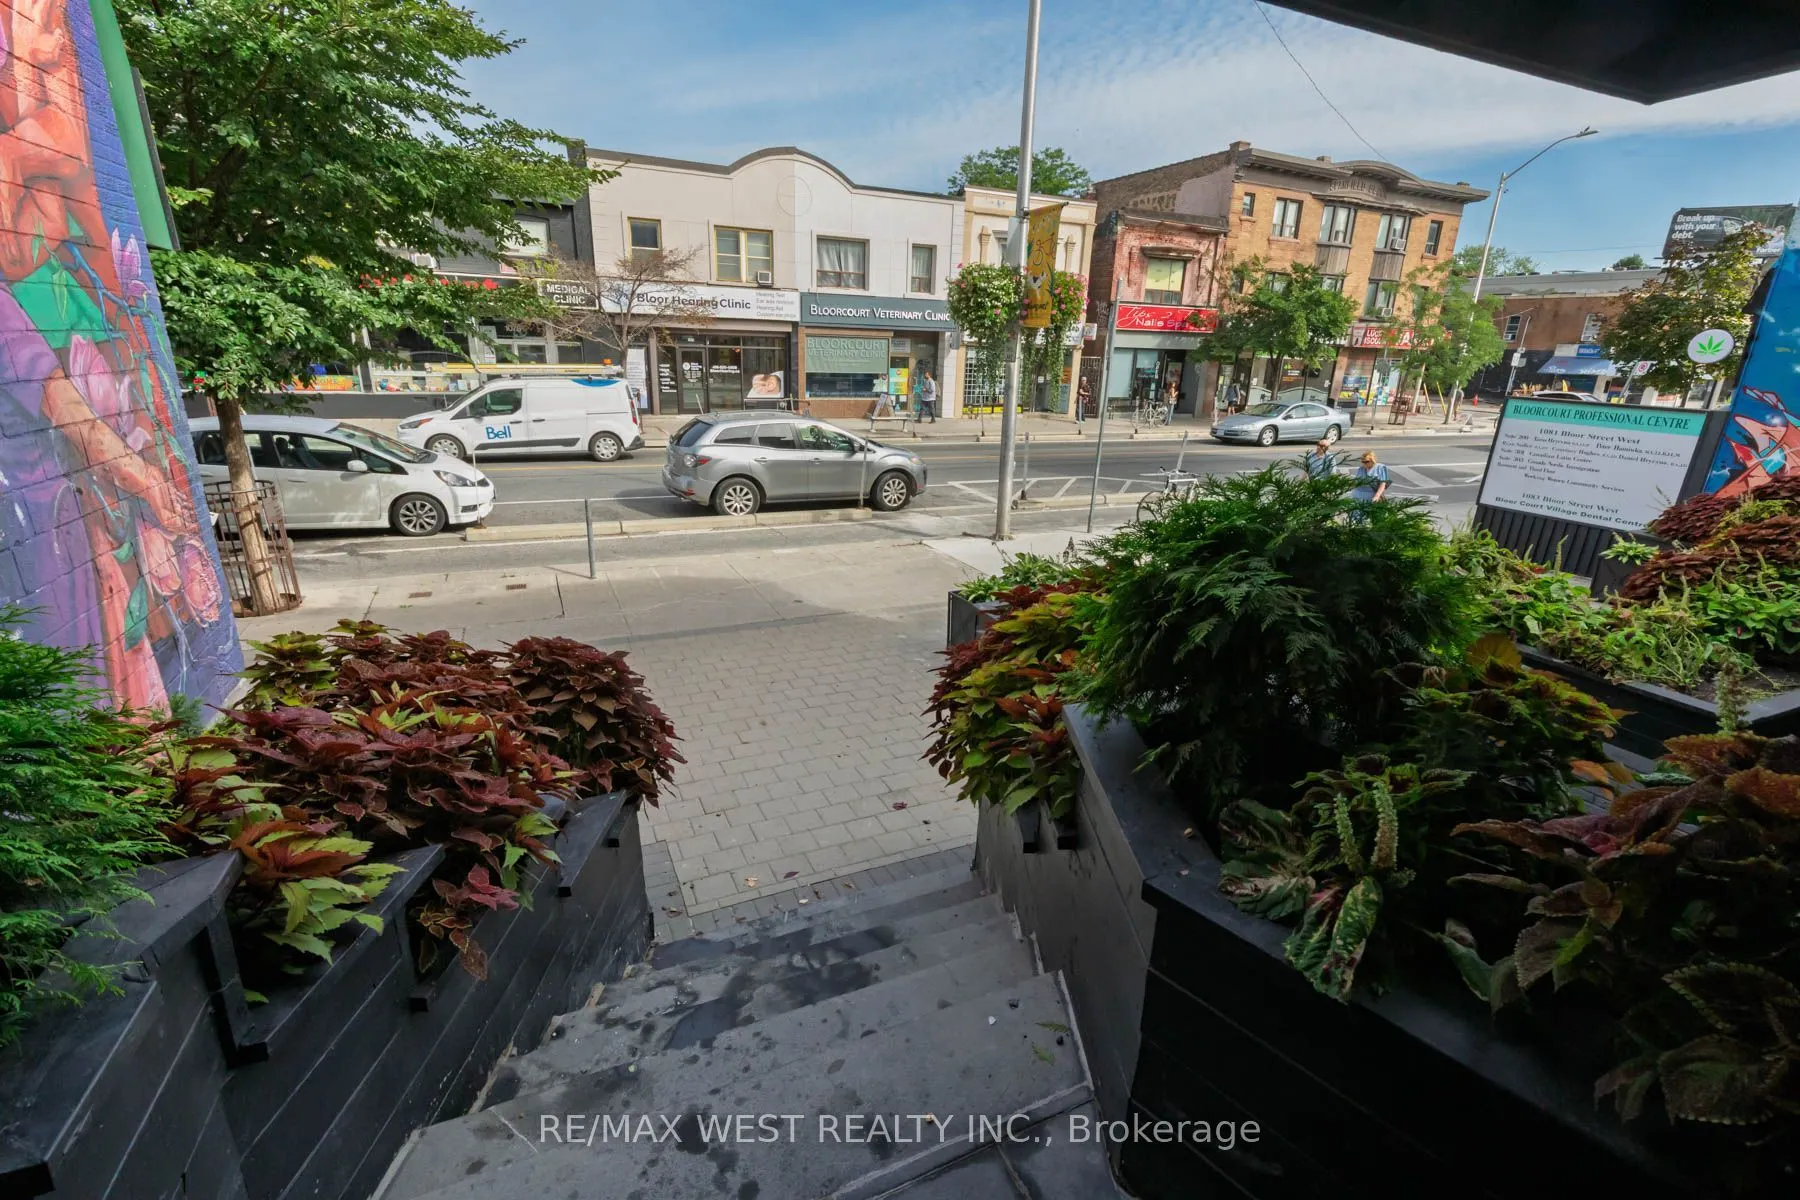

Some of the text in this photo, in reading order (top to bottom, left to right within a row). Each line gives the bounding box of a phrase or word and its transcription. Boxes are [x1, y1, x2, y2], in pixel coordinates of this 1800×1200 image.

[1677, 214, 1715, 224] Break up
[1695, 223, 1716, 232] your
[546, 284, 591, 295] MEDICAL
[553, 294, 586, 304] CLINIC
[637, 292, 751, 309] Bloor Hearing Clinic
[810, 304, 950, 321] BLOORCOURT VETERINARY CLINIC
[1136, 318, 1164, 326] Nails
[808, 338, 886, 350] BLOORCOURT
[808, 348, 886, 358] VETERINARY CLINIC
[1513, 404, 1692, 430] BLOORCOURT PROFESSIONAL CENTRE
[486, 425, 512, 439] Bell
[1561, 430, 1584, 438] Bloor
[1617, 436, 1640, 444] West
[1495, 496, 1517, 505] Bloor
[1520, 500, 1544, 509] Court
[1546, 503, 1578, 516] Village
[1580, 511, 1612, 521] Dental
[1542, 496, 1565, 505] Bloor
[1568, 500, 1593, 510] Street
[1597, 504, 1620, 514] West
